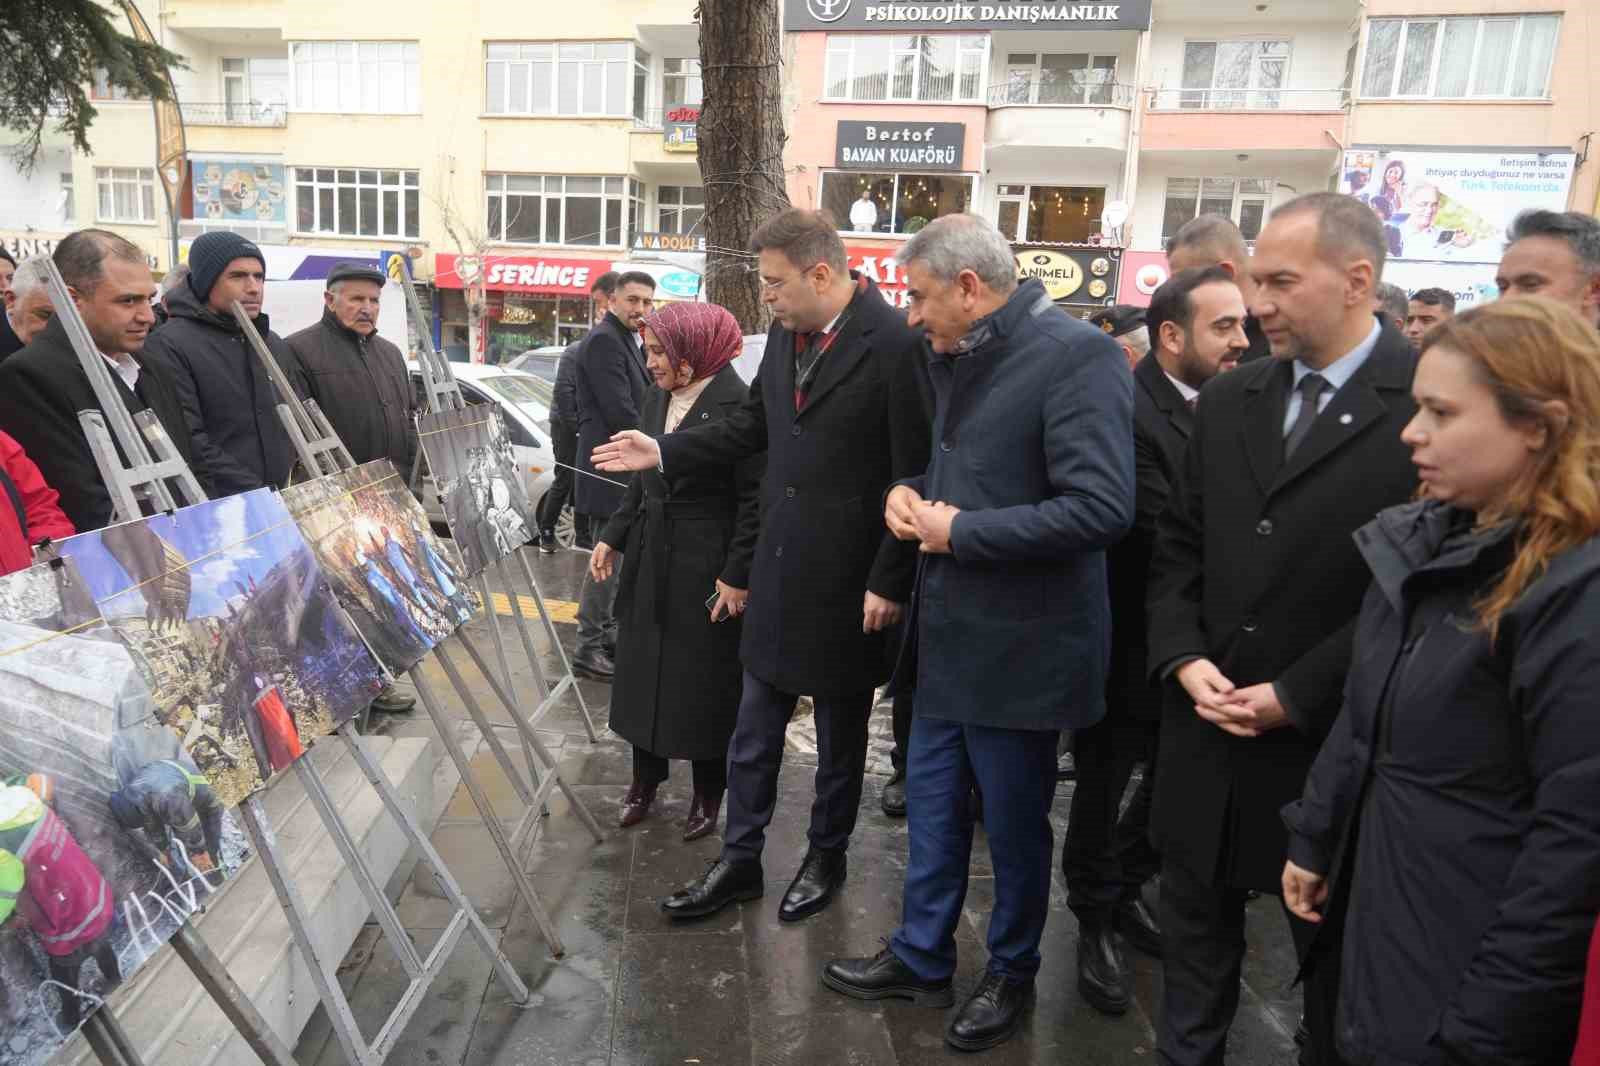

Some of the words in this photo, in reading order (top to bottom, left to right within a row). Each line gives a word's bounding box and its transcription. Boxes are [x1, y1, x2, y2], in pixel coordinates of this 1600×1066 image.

[864, 3, 976, 23] PSİKOLOJİK
[980, 6, 1120, 23] DANIŞMANLIK
[865, 126, 935, 142] Bestof
[842, 147, 885, 162] BAYAN
[890, 145, 955, 164] KUAFÖRÜ
[1523, 171, 1535, 179] ne
[1538, 171, 1565, 179] varsa
[487, 261, 589, 288] SERİNCE
[1020, 265, 1074, 279] ANIMELİ
